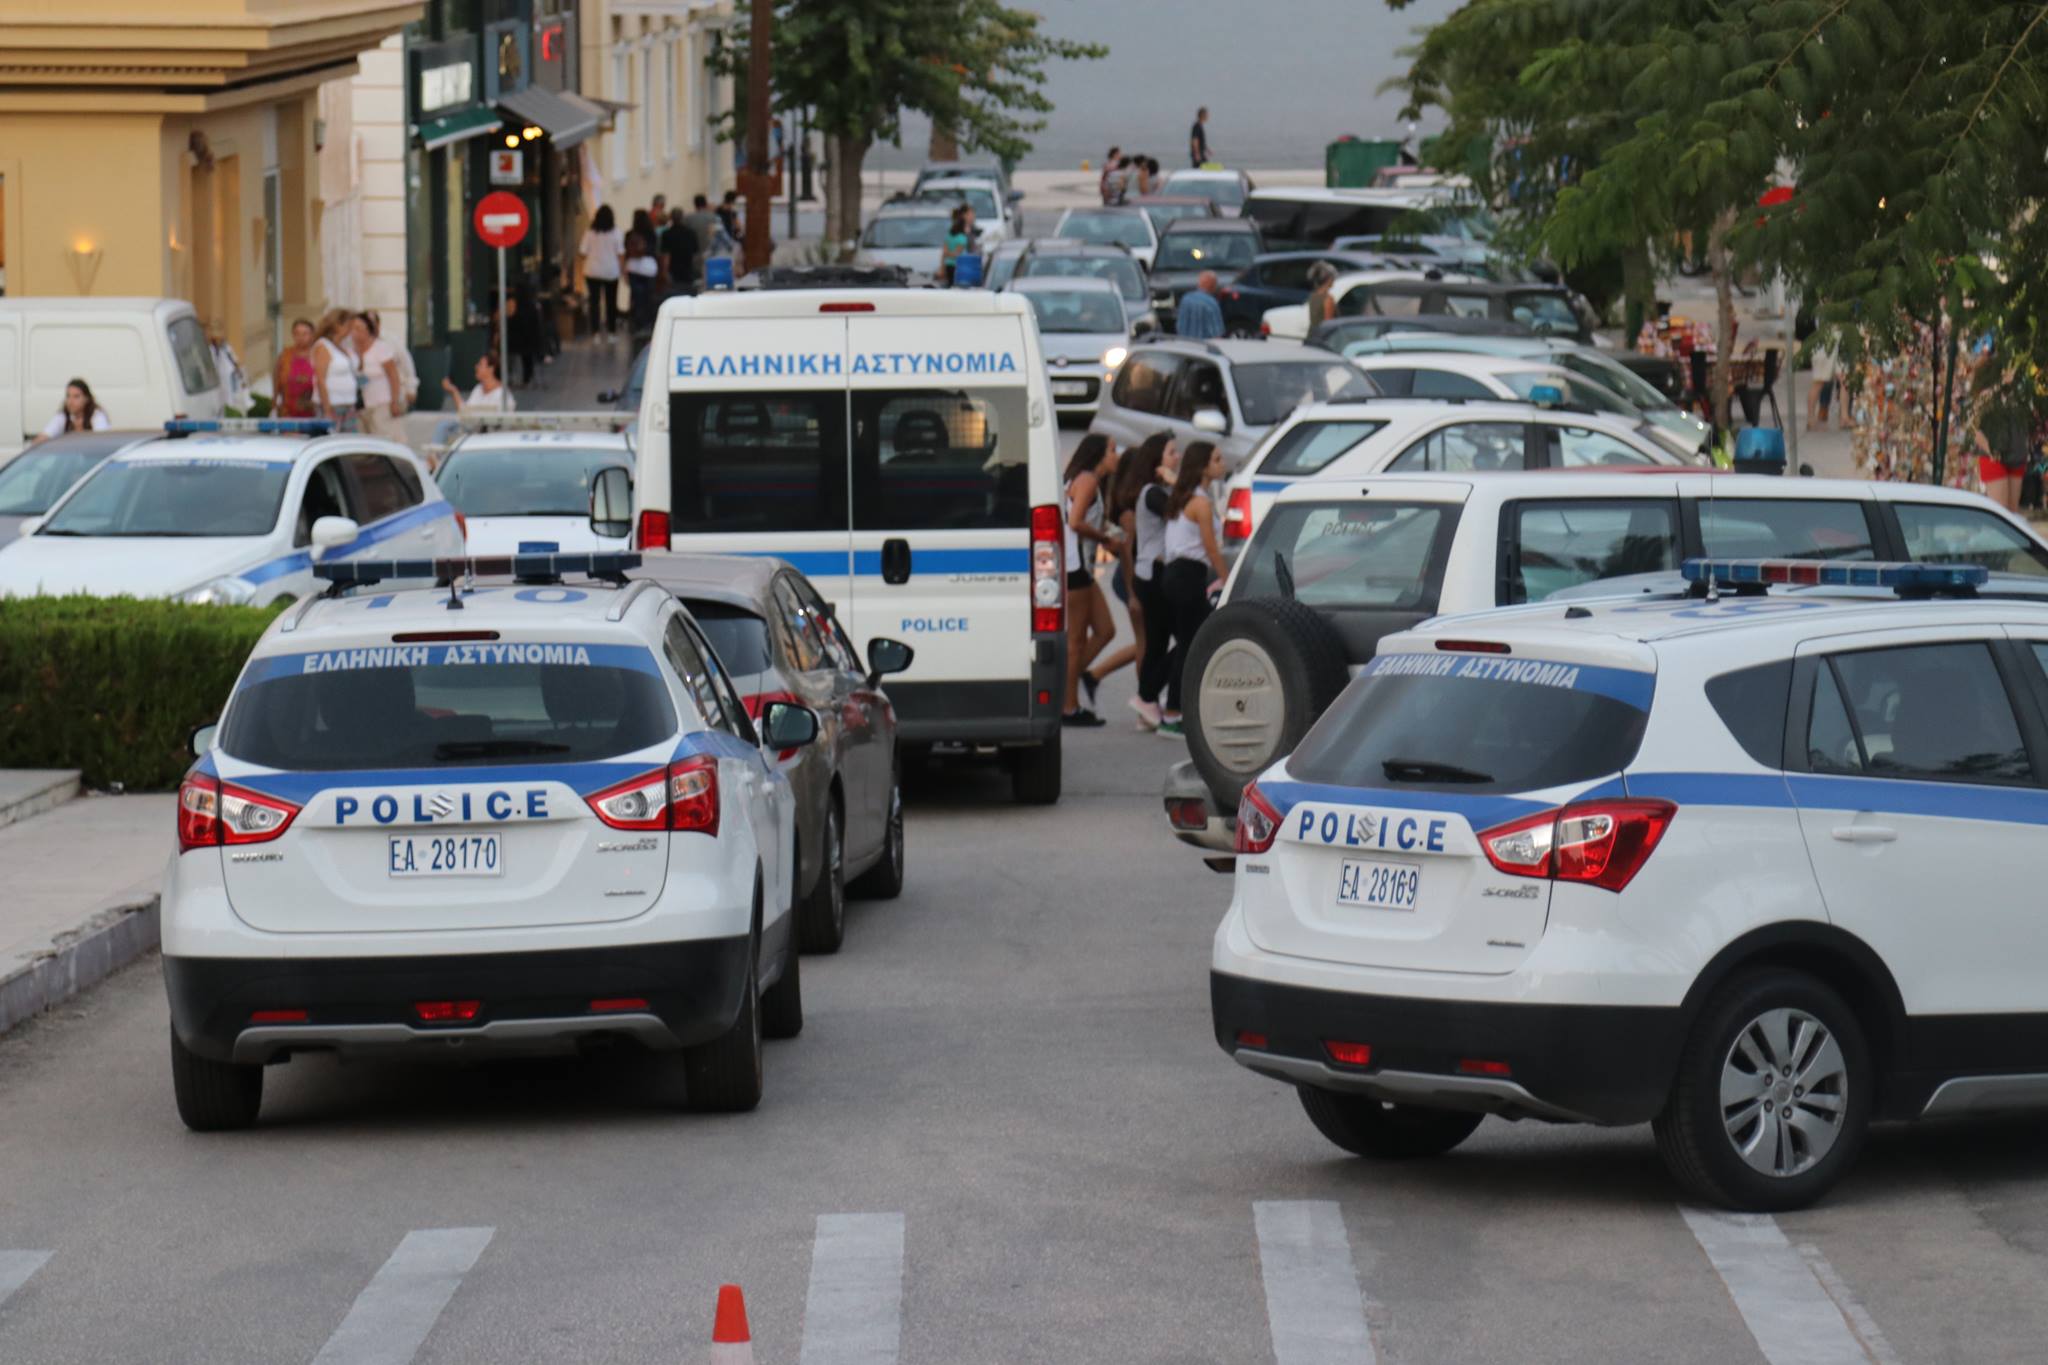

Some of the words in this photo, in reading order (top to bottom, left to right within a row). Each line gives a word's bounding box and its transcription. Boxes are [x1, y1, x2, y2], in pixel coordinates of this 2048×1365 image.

[676, 354, 841, 376] ΕΛΛΗΝΙΚΗ
[852, 352, 1016, 373] ΑΣΤΥΝΟΜΙΑ
[901, 617, 970, 633] POLICE
[303, 647, 429, 674] ΕΛΛΗΝΙΚΗ
[443, 644, 591, 666] ΑΣΤΥΝΟΜΙΑ
[1372, 655, 1458, 676] ΕΛΛΗΝΙΚΗ
[1456, 657, 1580, 689] ΑΣΤΥΝΟΜΙΑ
[431, 838, 497, 870] 28170
[1368, 866, 1418, 905] 28169
